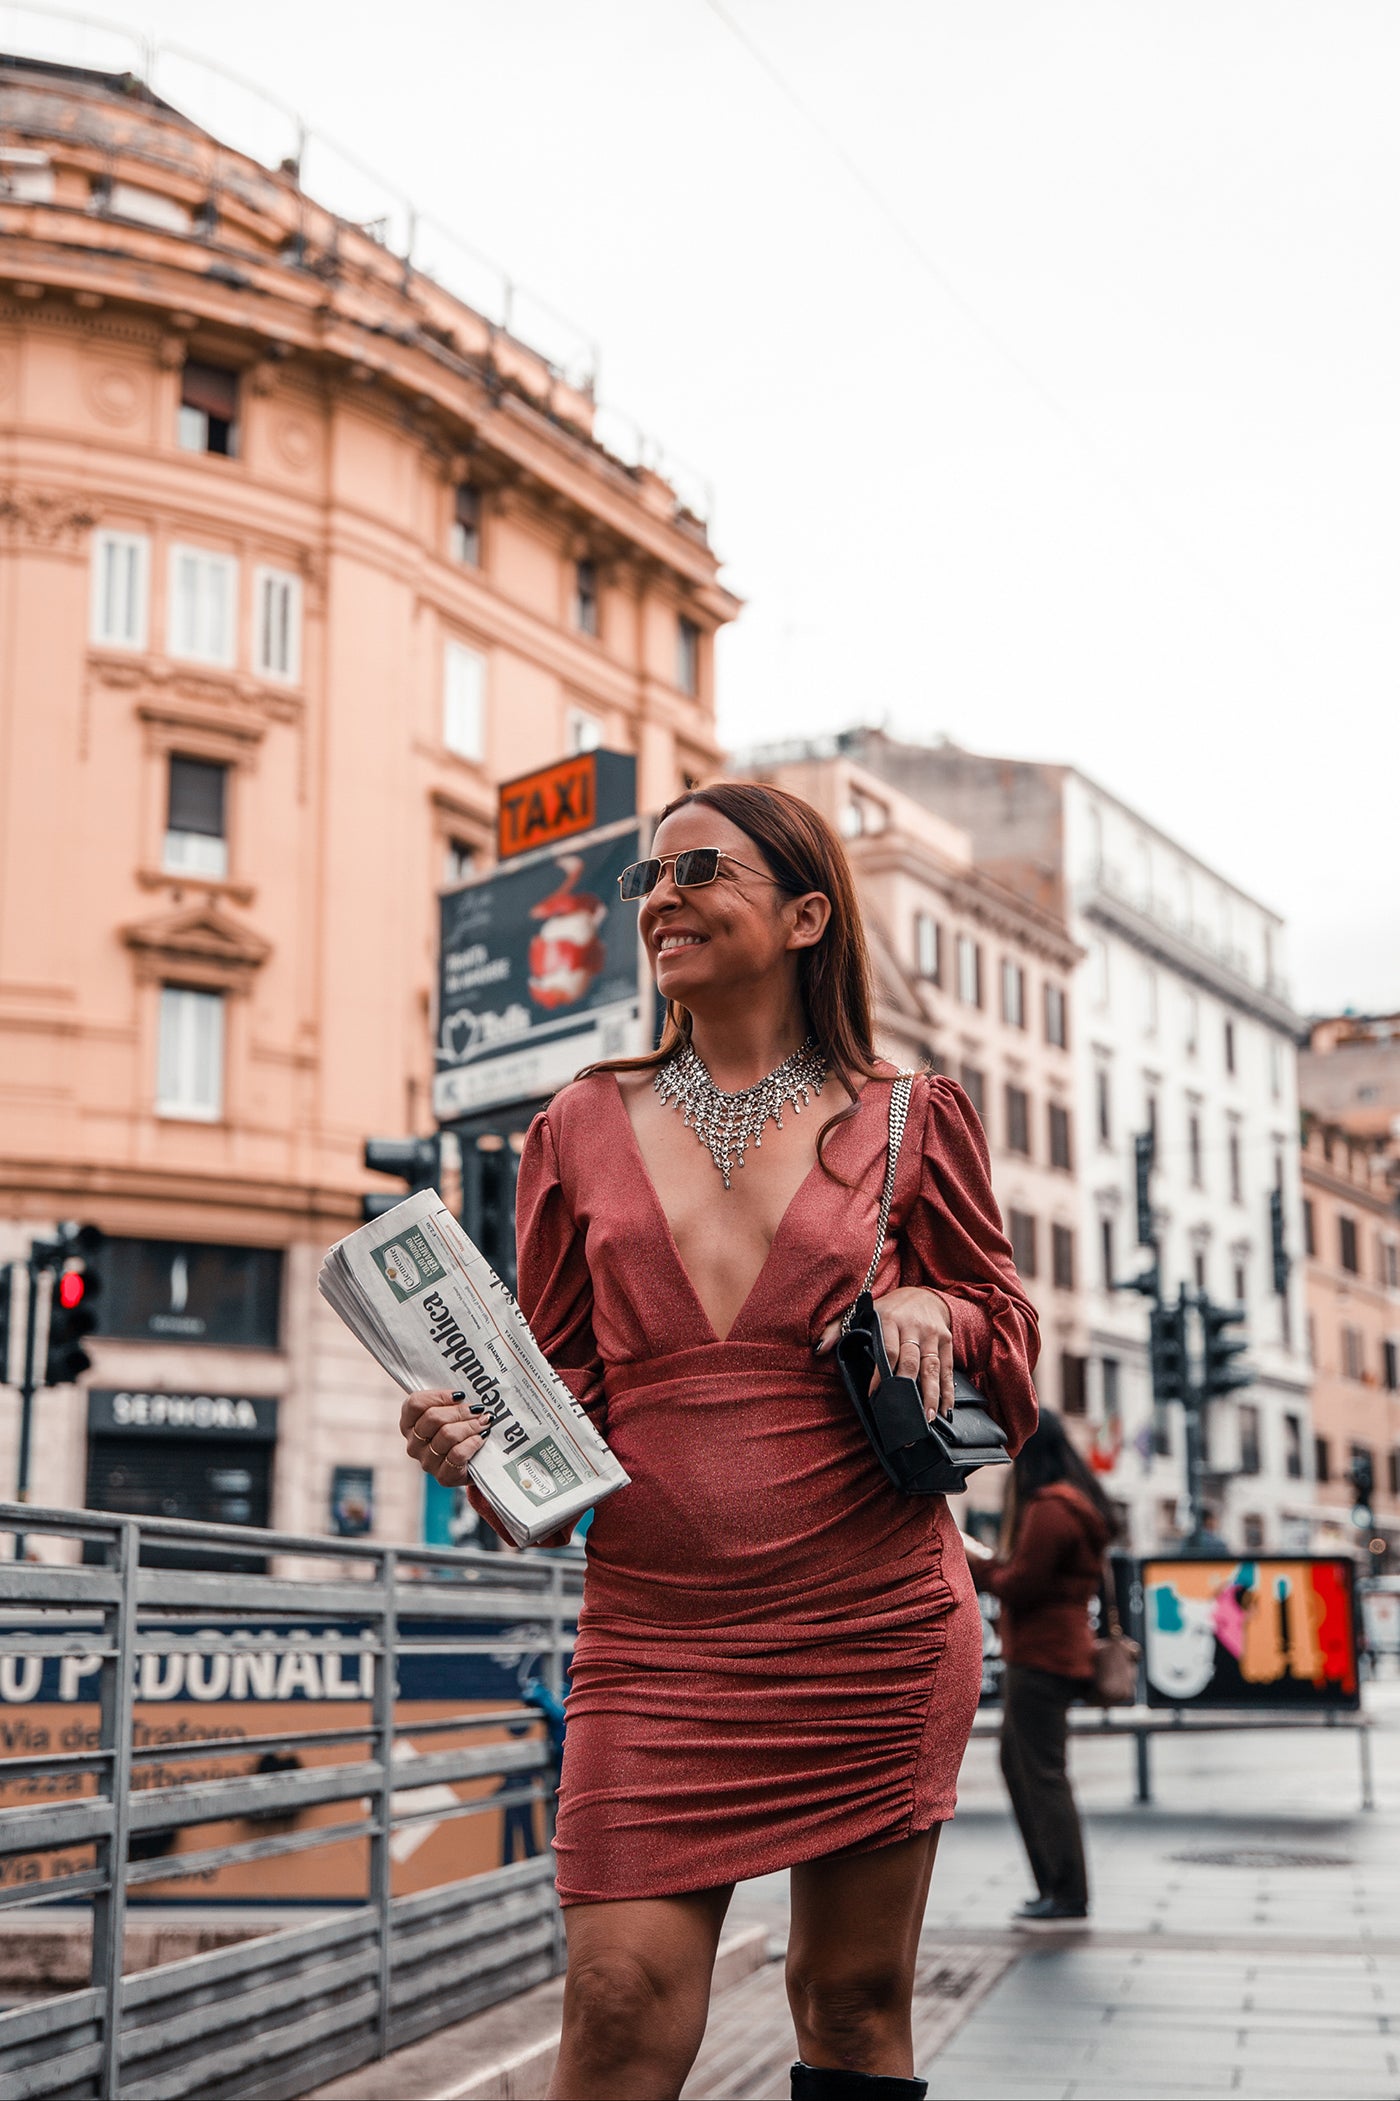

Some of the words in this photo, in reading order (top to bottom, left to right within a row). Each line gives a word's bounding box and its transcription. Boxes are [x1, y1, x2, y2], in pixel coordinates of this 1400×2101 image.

[505, 775, 589, 841] TAXI
[404, 1237, 421, 1259] BUONO
[411, 1232, 440, 1273] VERAMENTE
[388, 1247, 414, 1286] Clemente
[417, 1257, 433, 1277] L'OLIO
[421, 1290, 513, 1428] Repubblica
[528, 1363, 544, 1384] PATTO
[541, 1382, 558, 1403] NUOVO
[113, 1393, 257, 1429] SEPHORA
[502, 1420, 530, 1454] la
[538, 1447, 556, 1471] BUONO
[545, 1442, 575, 1483] VERAMENTE
[522, 1460, 550, 1495] Clemente
[59, 1629, 401, 1701] PDONAL
[0, 1717, 49, 1749] Via
[61, 1716, 101, 1749] de
